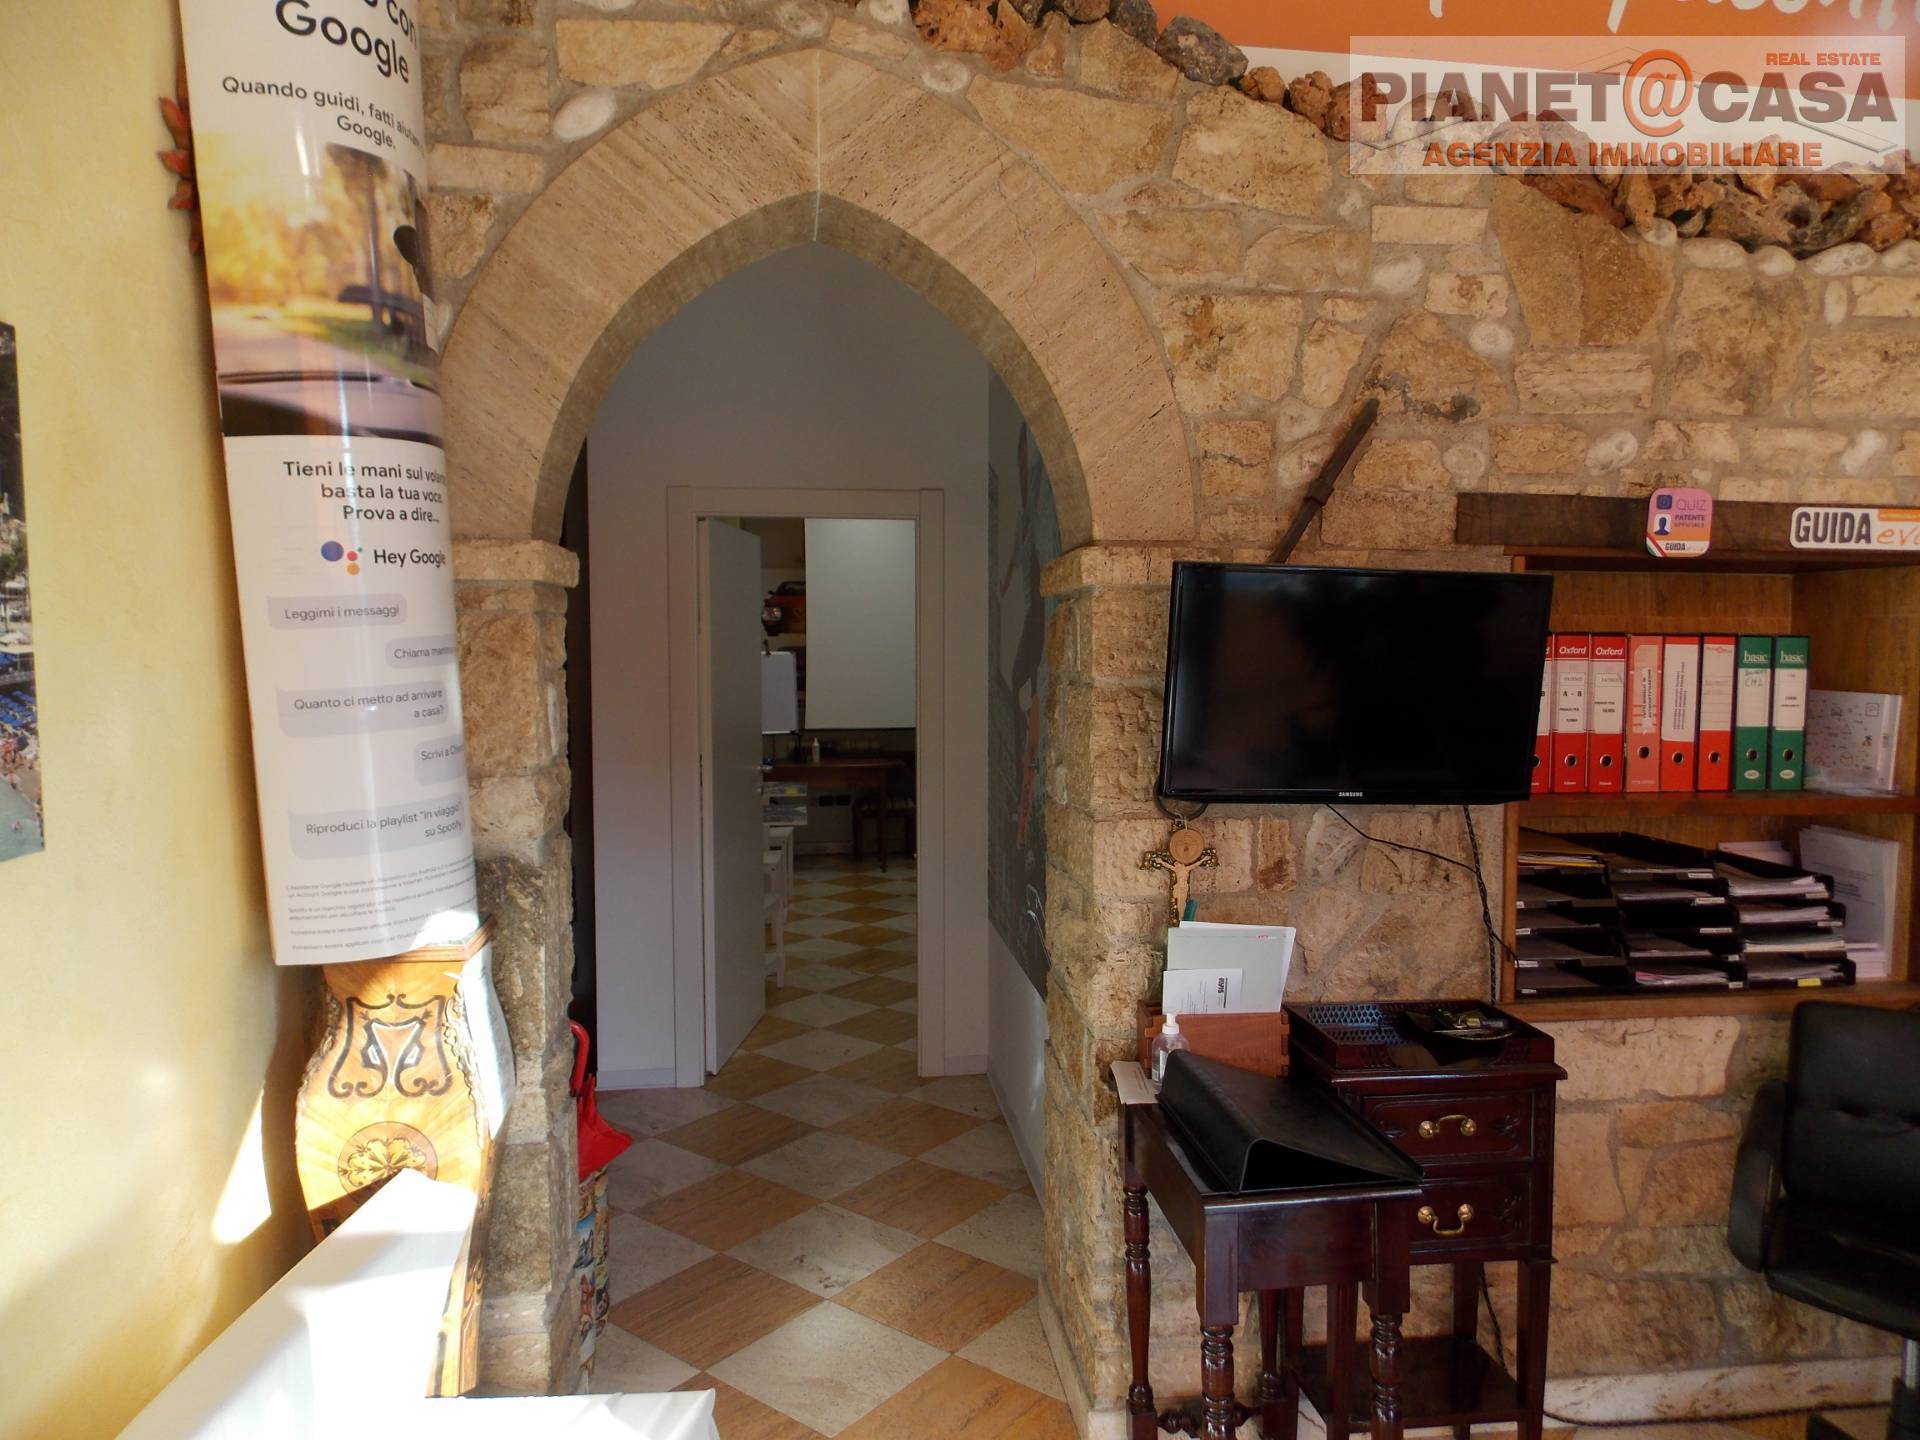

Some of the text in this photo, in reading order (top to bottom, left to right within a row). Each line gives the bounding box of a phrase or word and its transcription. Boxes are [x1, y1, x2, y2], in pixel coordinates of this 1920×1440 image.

[386, 0, 417, 48] con
[275, 0, 409, 83] Google
[222, 76, 307, 99] Quando
[313, 91, 365, 115] guidi,
[369, 103, 395, 127] fatti
[337, 115, 396, 149] Google.
[283, 461, 332, 476] Tieni
[339, 462, 355, 476] le
[361, 464, 402, 478] mani
[406, 465, 423, 480] sul
[380, 484, 393, 499] la
[398, 487, 420, 501] tua
[1676, 497, 1706, 511] QUIZ
[343, 505, 395, 520] Prova
[399, 510, 408, 521] a
[1795, 511, 1871, 544] GUIDA
[1665, 542, 1686, 551] GUIDA
[374, 549, 407, 567] Hey
[284, 607, 334, 621] Leggimi
[344, 604, 399, 618] messaggi
[394, 647, 430, 659] Chiama
[1559, 646, 1587, 655] Oxford
[1595, 647, 1623, 655] Oxford
[1744, 650, 1768, 661] basic
[1780, 650, 1804, 661] basic
[293, 689, 442, 711] Quanto ci metto ad arrivare
[414, 710, 420, 718] a
[306, 821, 364, 834] Riproduci
[380, 813, 418, 829] playlist
[425, 828, 436, 837] su
